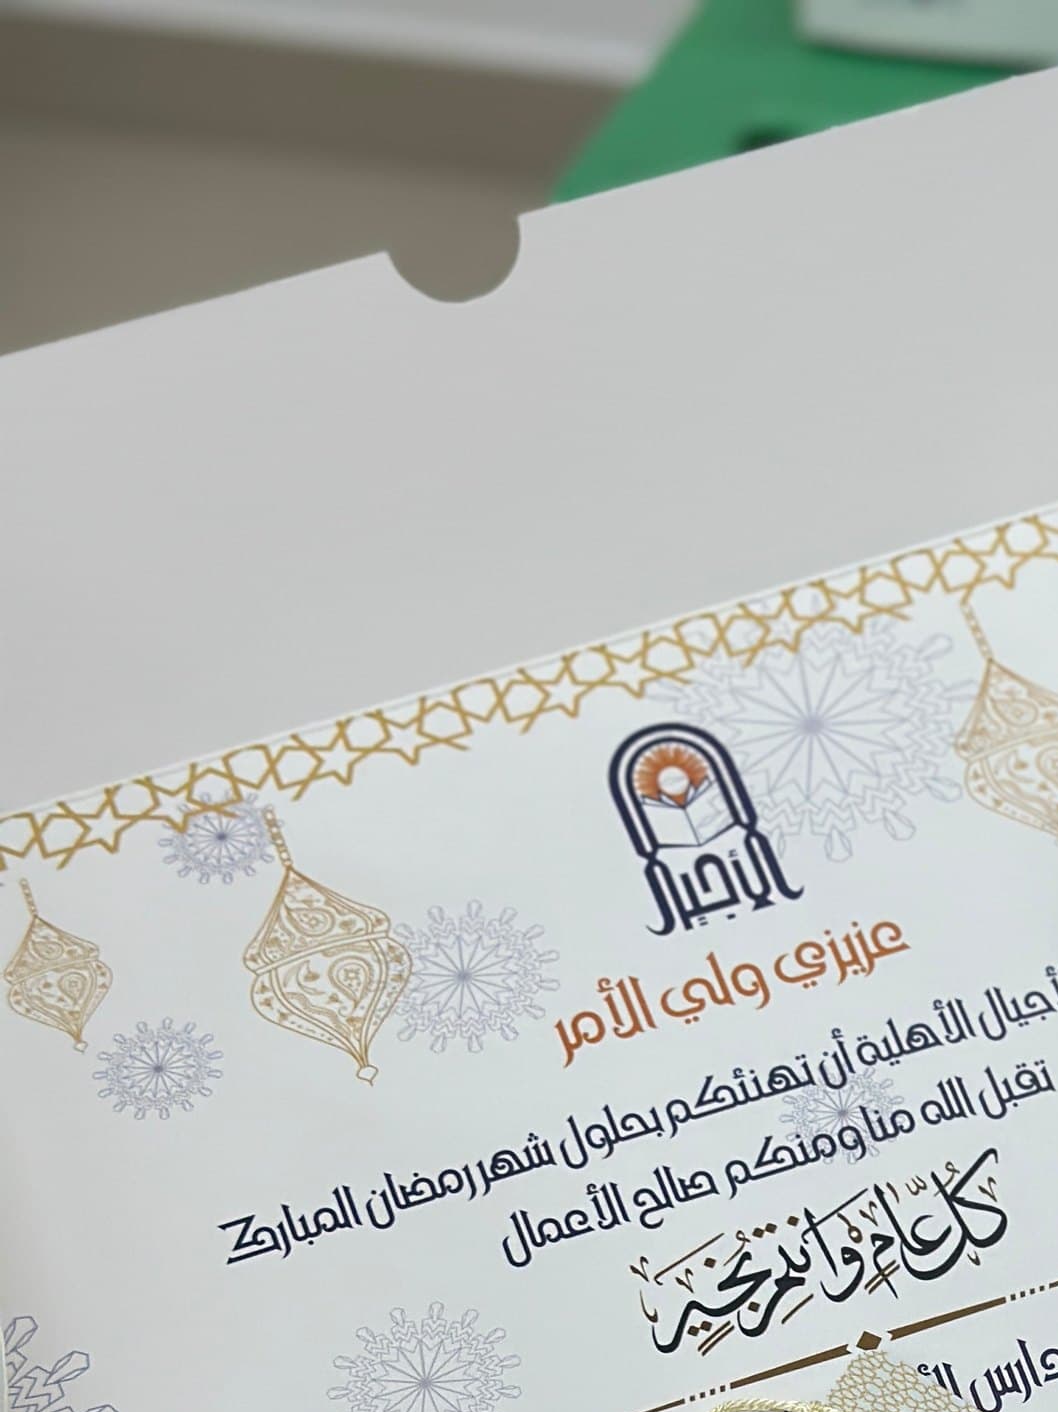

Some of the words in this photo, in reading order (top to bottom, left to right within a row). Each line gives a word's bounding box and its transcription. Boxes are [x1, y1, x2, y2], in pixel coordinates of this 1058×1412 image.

[774, 919, 911, 988] عزيزي
[552, 975, 656, 1068] الأمر
[660, 953, 770, 1026] ولي
[818, 1027, 856, 1090] أن
[857, 998, 977, 1068] الأهلية
[666, 1053, 816, 1138] تهنئكم
[920, 1076, 976, 1128] الله
[976, 1058, 1057, 1120] تقبل
[559, 1104, 664, 1170] بحلول
[860, 1105, 916, 1142] منا
[365, 1163, 479, 1230] رمضان
[480, 1131, 558, 1197] شهر
[632, 1164, 721, 1230] صالح
[217, 1184, 364, 1266] المبارك
[502, 1182, 630, 1269] الأعمال
